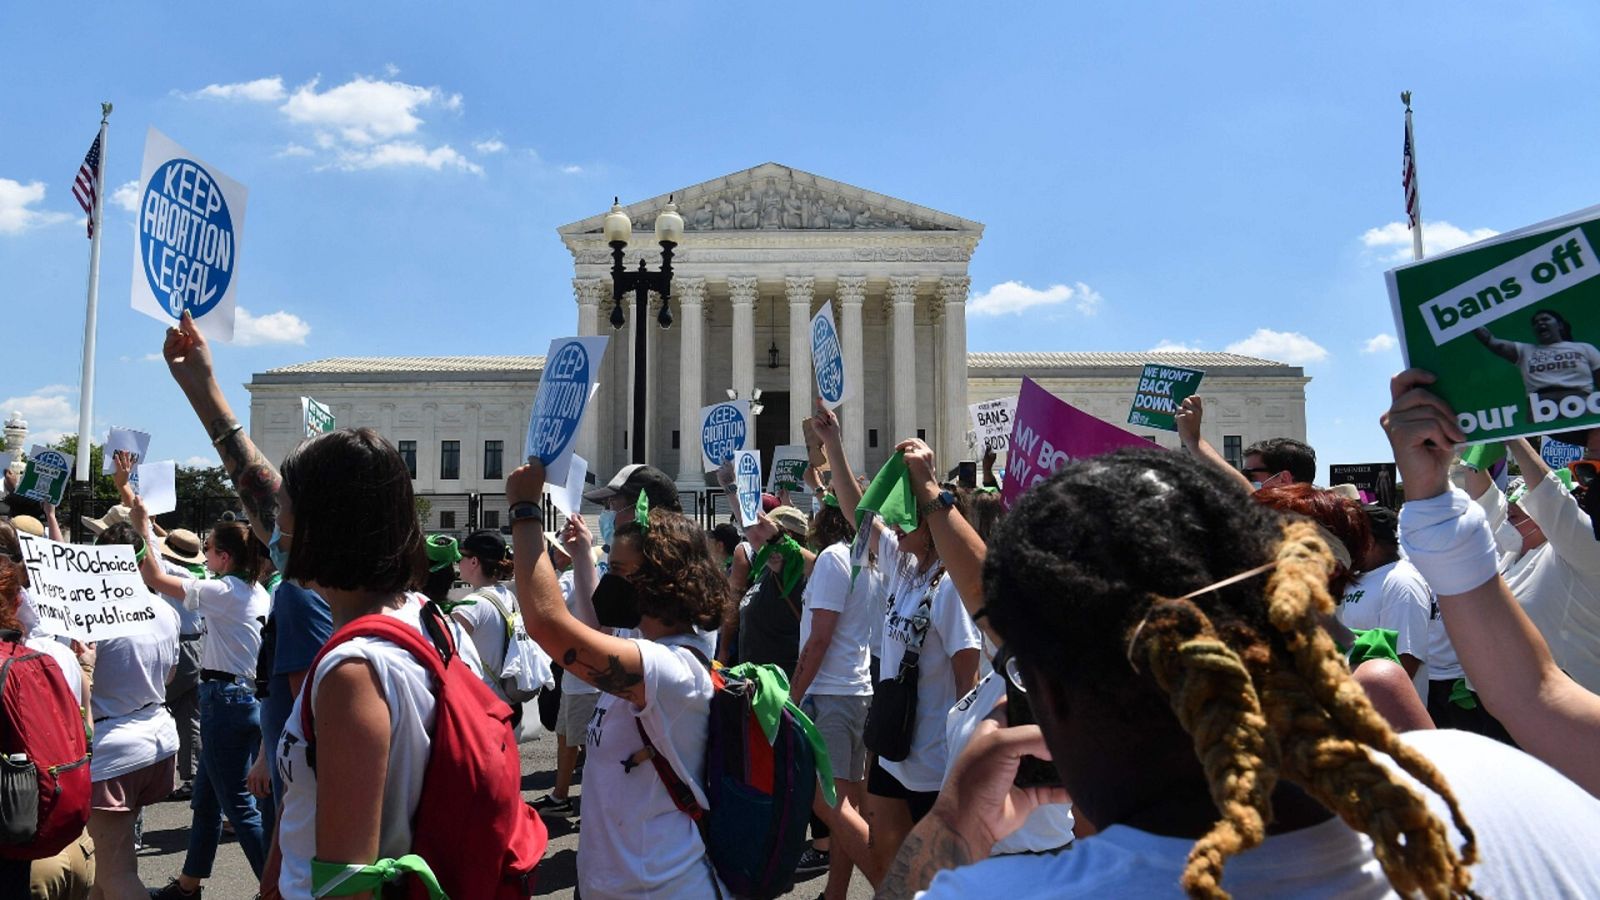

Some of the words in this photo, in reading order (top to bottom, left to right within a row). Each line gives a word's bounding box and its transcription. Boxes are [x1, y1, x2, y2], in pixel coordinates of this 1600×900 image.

[163, 162, 222, 219] KEEP
[143, 188, 231, 272] ABORTION
[148, 239, 217, 306] LEGAL
[1430, 276, 1522, 331] bans
[1531, 237, 1585, 285] off
[549, 345, 585, 380] KEEP
[1144, 366, 1159, 378] WE
[1159, 368, 1194, 383] WON'T
[1529, 360, 1577, 374] BODIES
[1139, 378, 1174, 396] BACK
[709, 406, 737, 426] KEEP
[977, 409, 1009, 426] BANS
[1135, 394, 1176, 413] DOWN.
[704, 420, 745, 443] ABORTION
[1457, 405, 1519, 434] our
[529, 417, 567, 456] LEGAL
[983, 433, 1013, 451] BODY
[1015, 418, 1040, 456] MY
[1543, 446, 1580, 457] ABORTION
[1010, 448, 1031, 487] MY
[51, 543, 137, 574] PROchoice
[28, 566, 67, 600] There
[69, 587, 96, 602] are
[100, 578, 134, 602] too
[1346, 590, 1365, 603] off
[37, 603, 69, 631] many
[64, 605, 156, 634] Republicans
